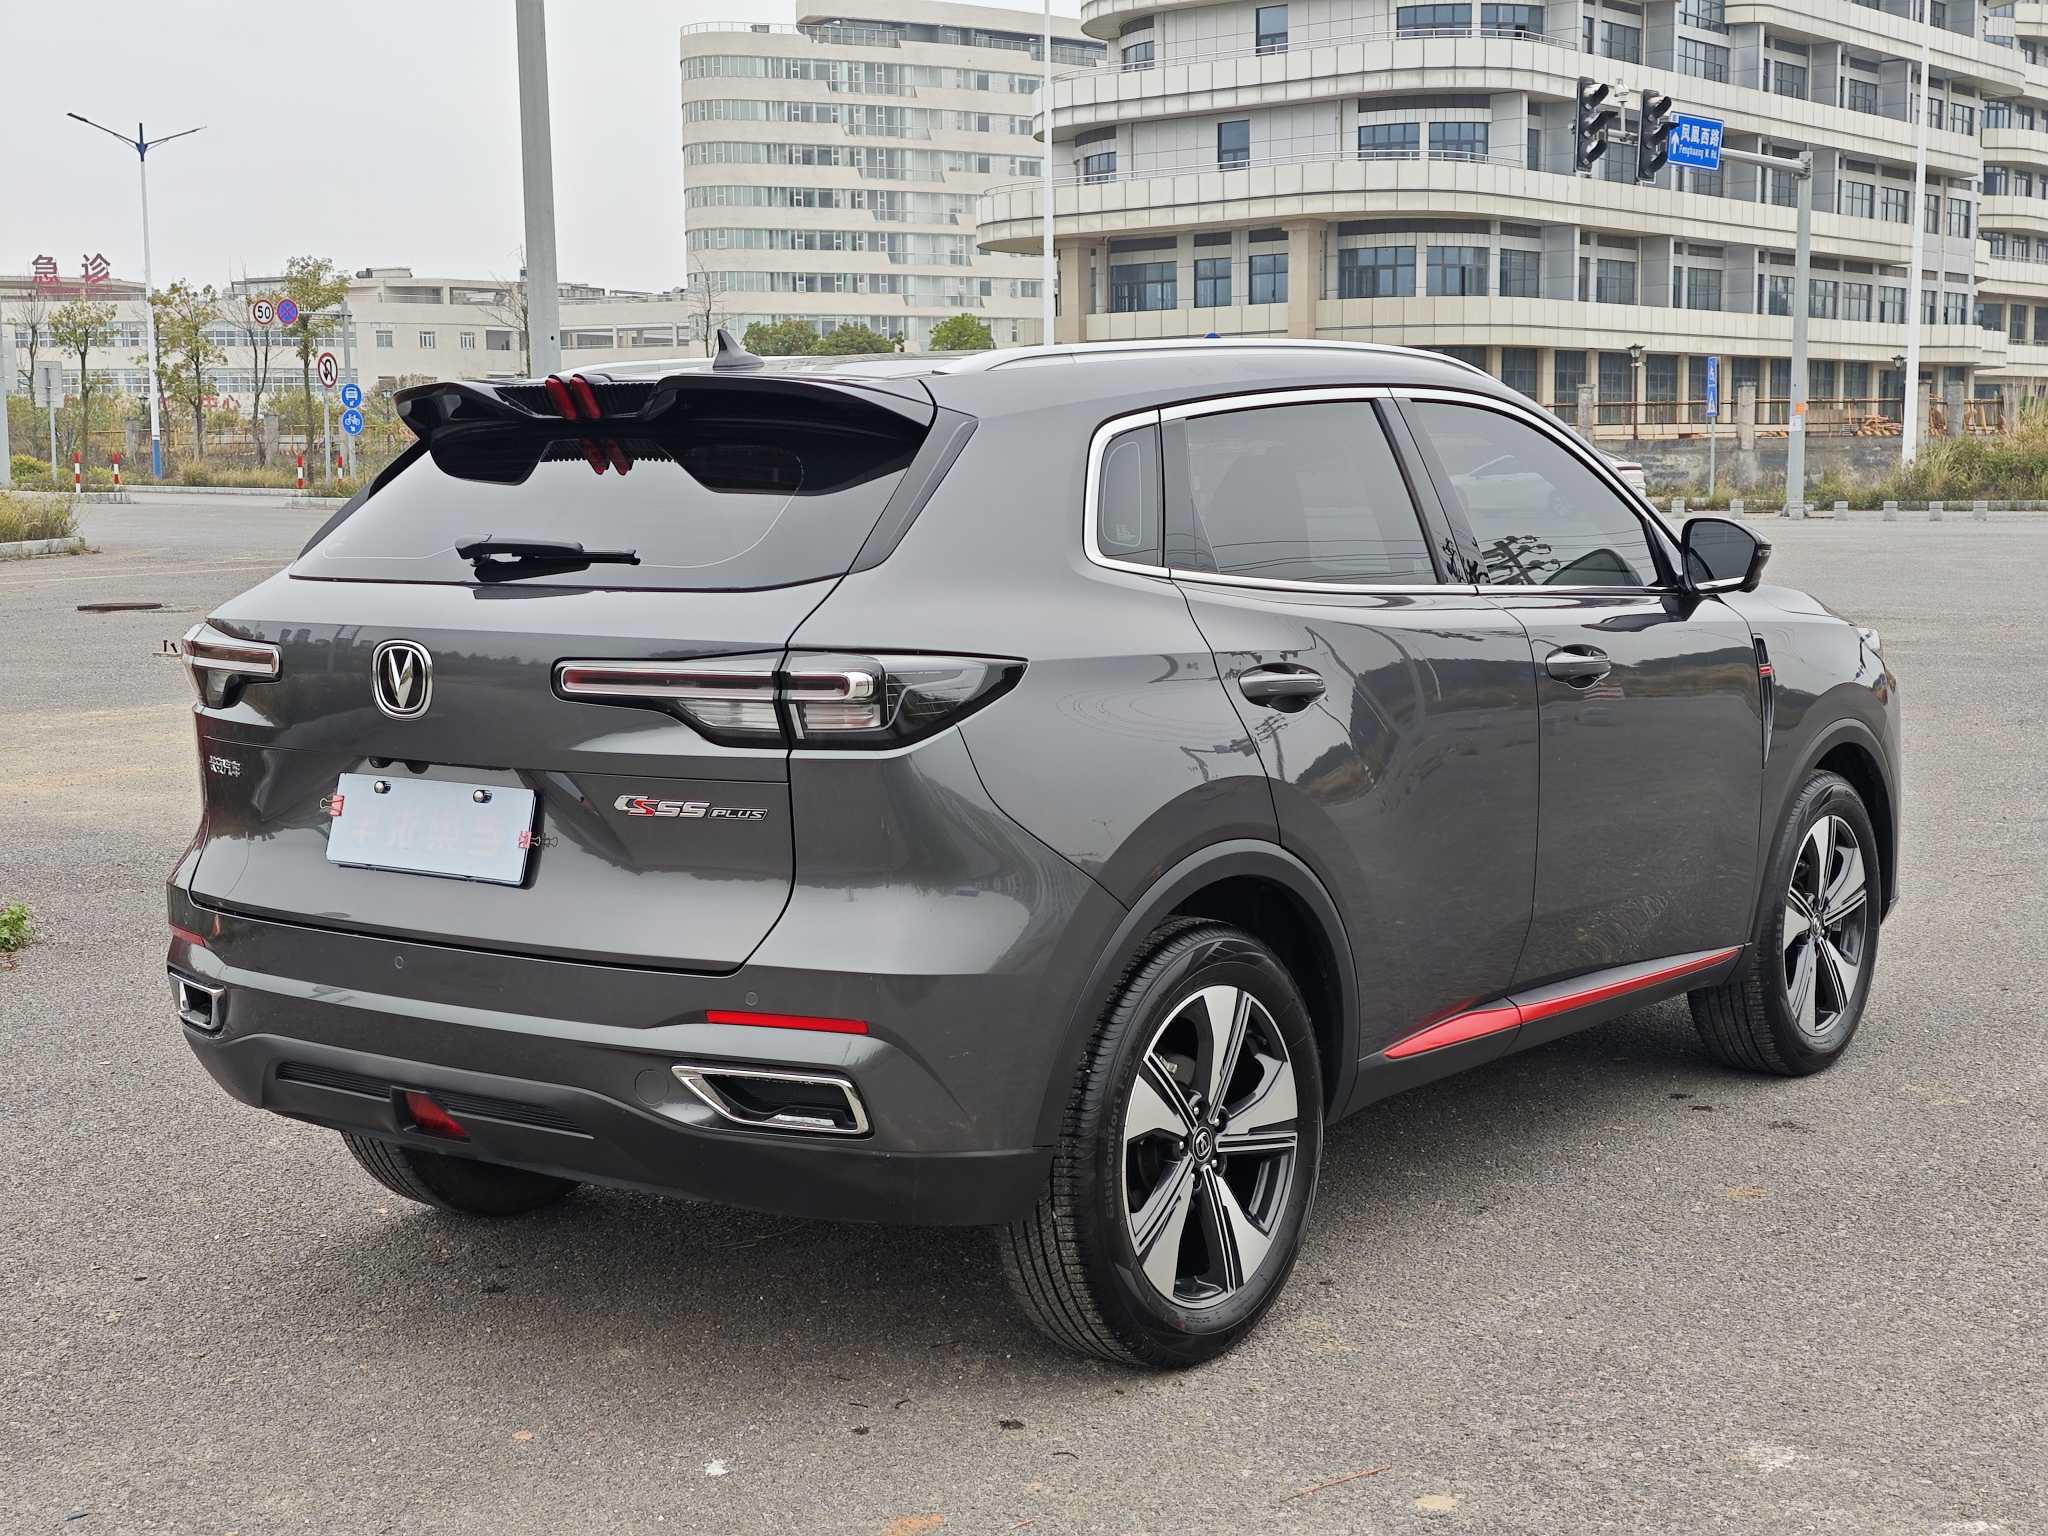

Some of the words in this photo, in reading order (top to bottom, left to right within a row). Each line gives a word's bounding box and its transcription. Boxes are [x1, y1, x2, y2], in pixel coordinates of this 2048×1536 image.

[1681, 124, 1719, 146] 凤凰西路
[31, 253, 112, 284] 急诊
[257, 305, 271, 320] 50
[709, 808, 766, 820] PLUS
